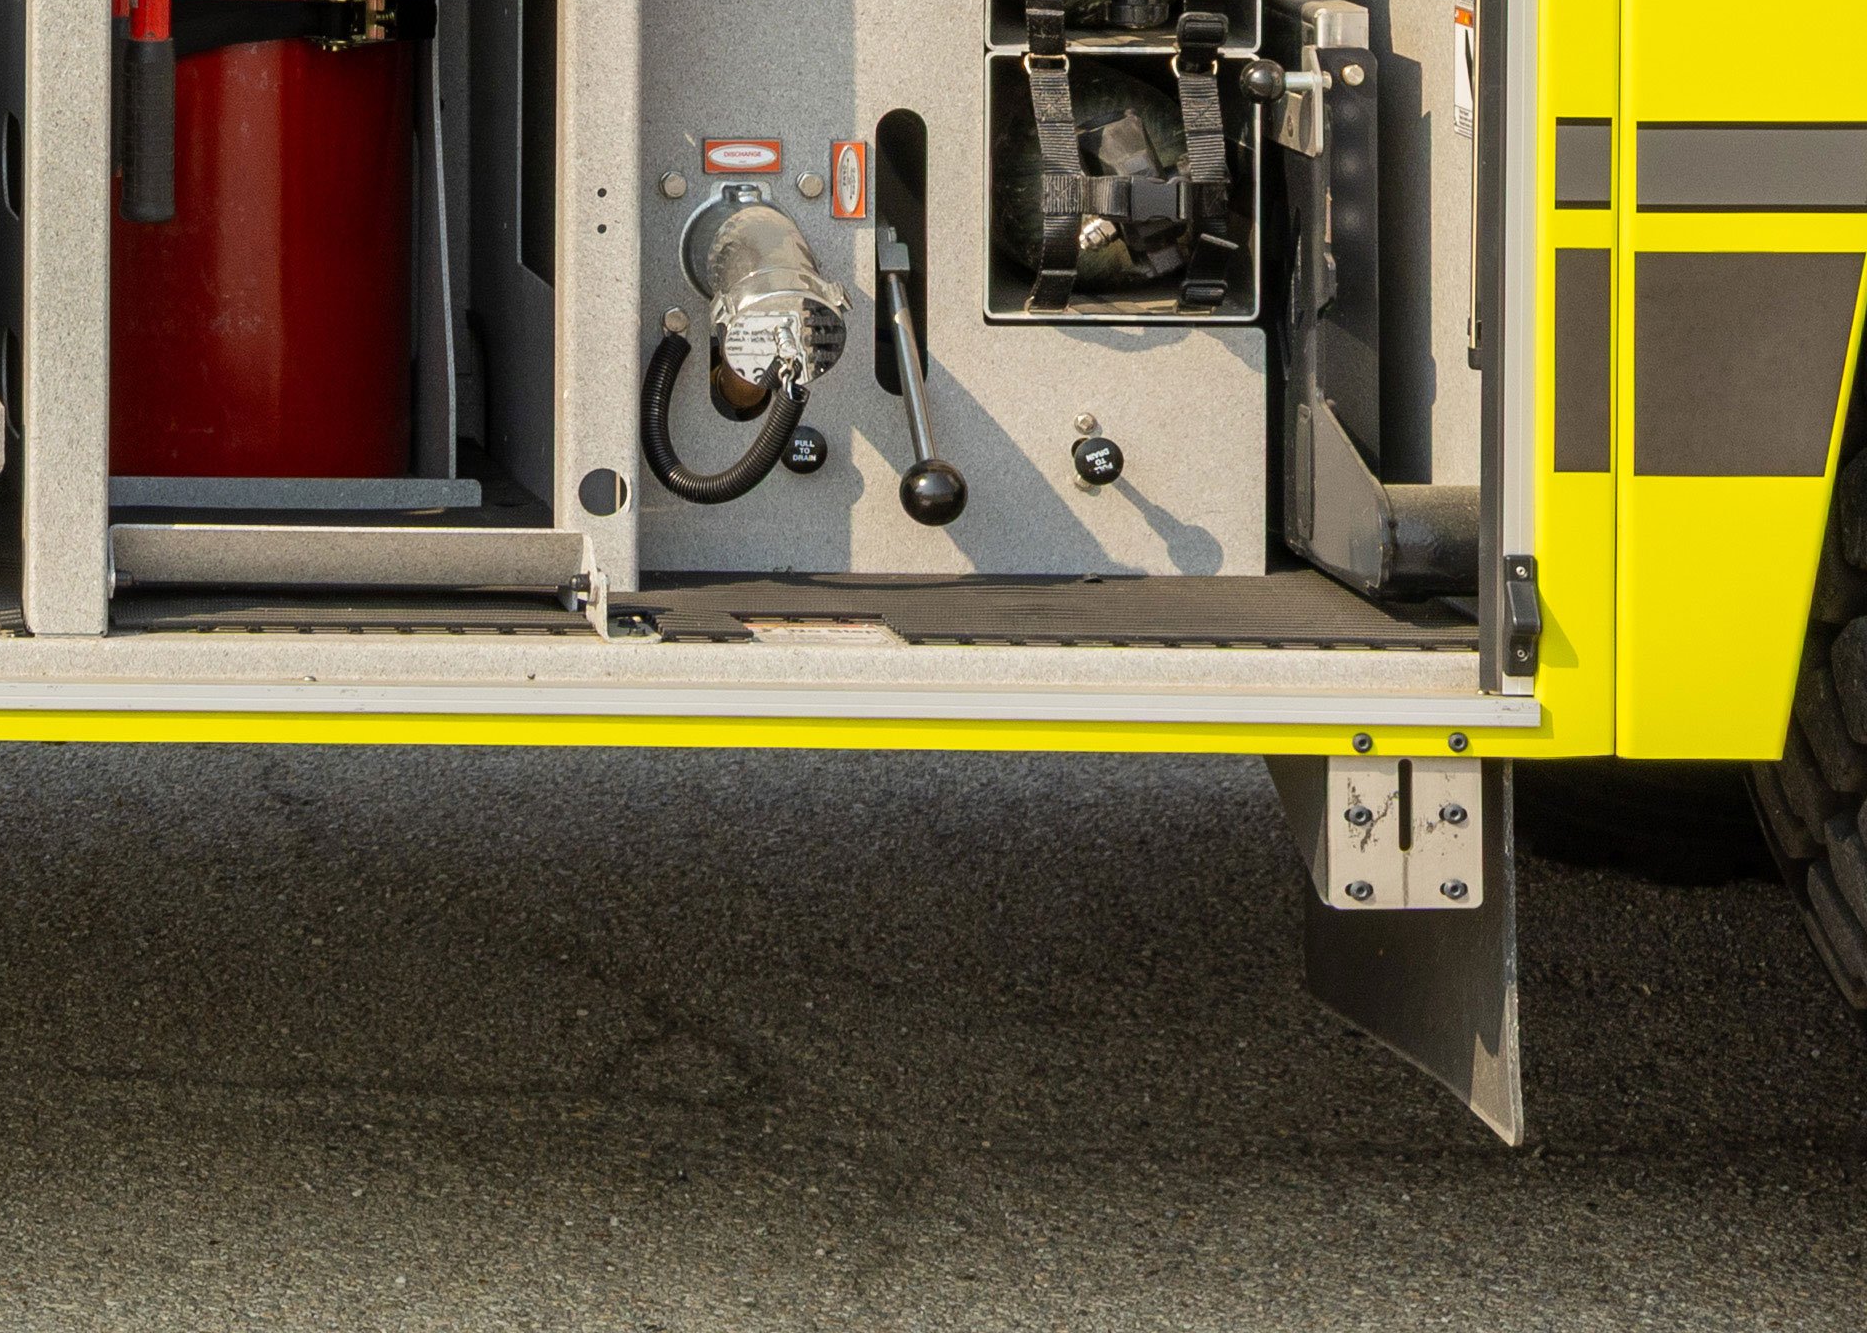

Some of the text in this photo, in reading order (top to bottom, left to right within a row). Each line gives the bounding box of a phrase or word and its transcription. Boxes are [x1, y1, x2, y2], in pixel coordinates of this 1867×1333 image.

[794, 439, 815, 448] PULL
[792, 454, 817, 462] DRAIN
[1095, 457, 1107, 466] TO
